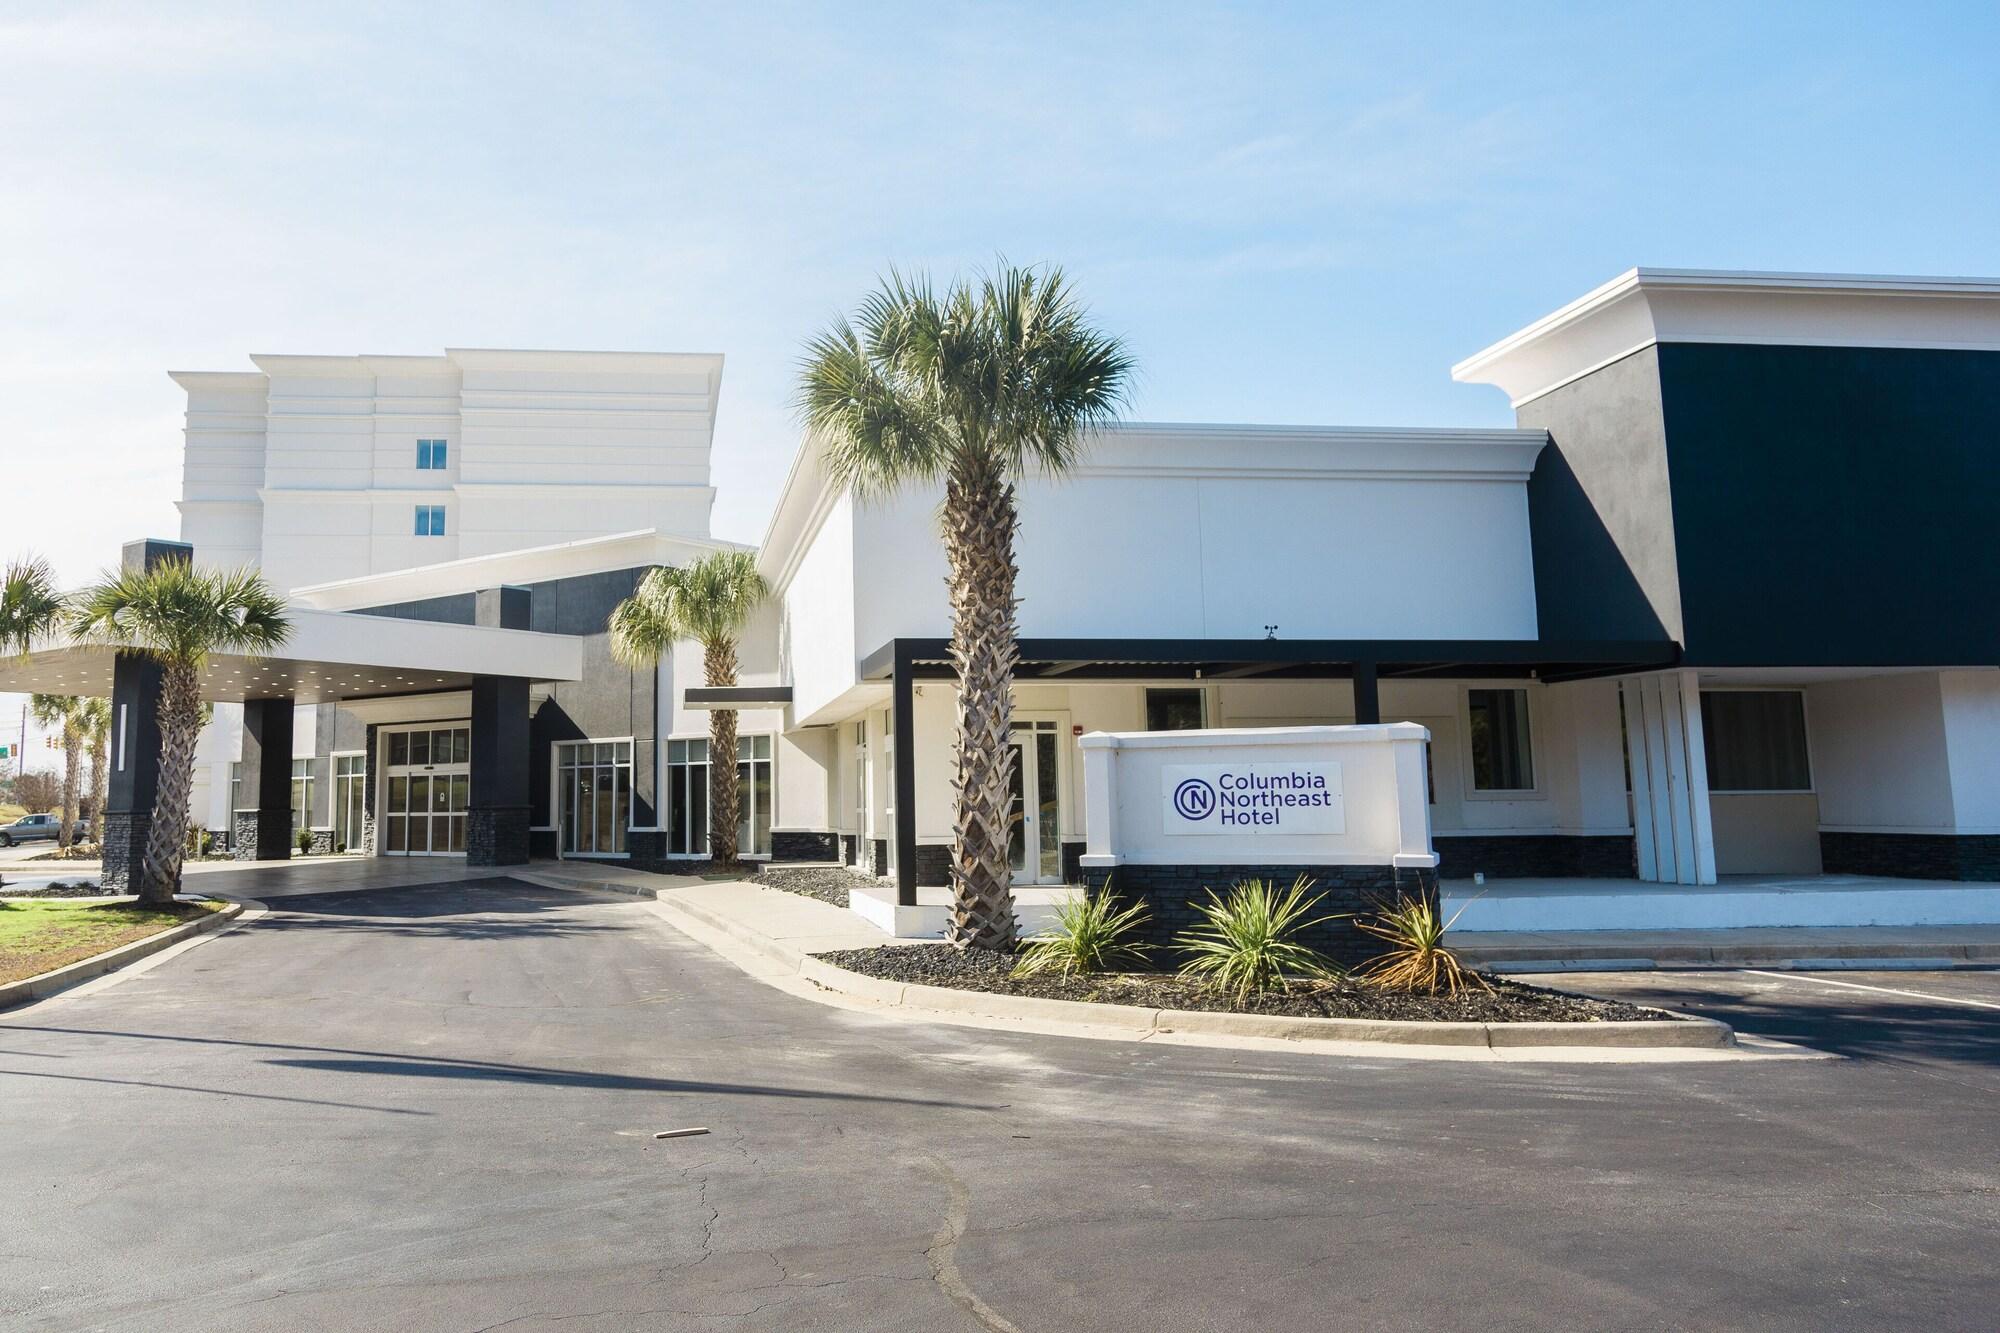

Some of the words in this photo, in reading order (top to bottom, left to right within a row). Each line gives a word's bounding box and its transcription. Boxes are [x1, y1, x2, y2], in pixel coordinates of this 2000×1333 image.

[1219, 772, 1326, 790] Columbia
[1220, 790, 1332, 808] Northeast
[1220, 808, 1280, 826] Hotel
